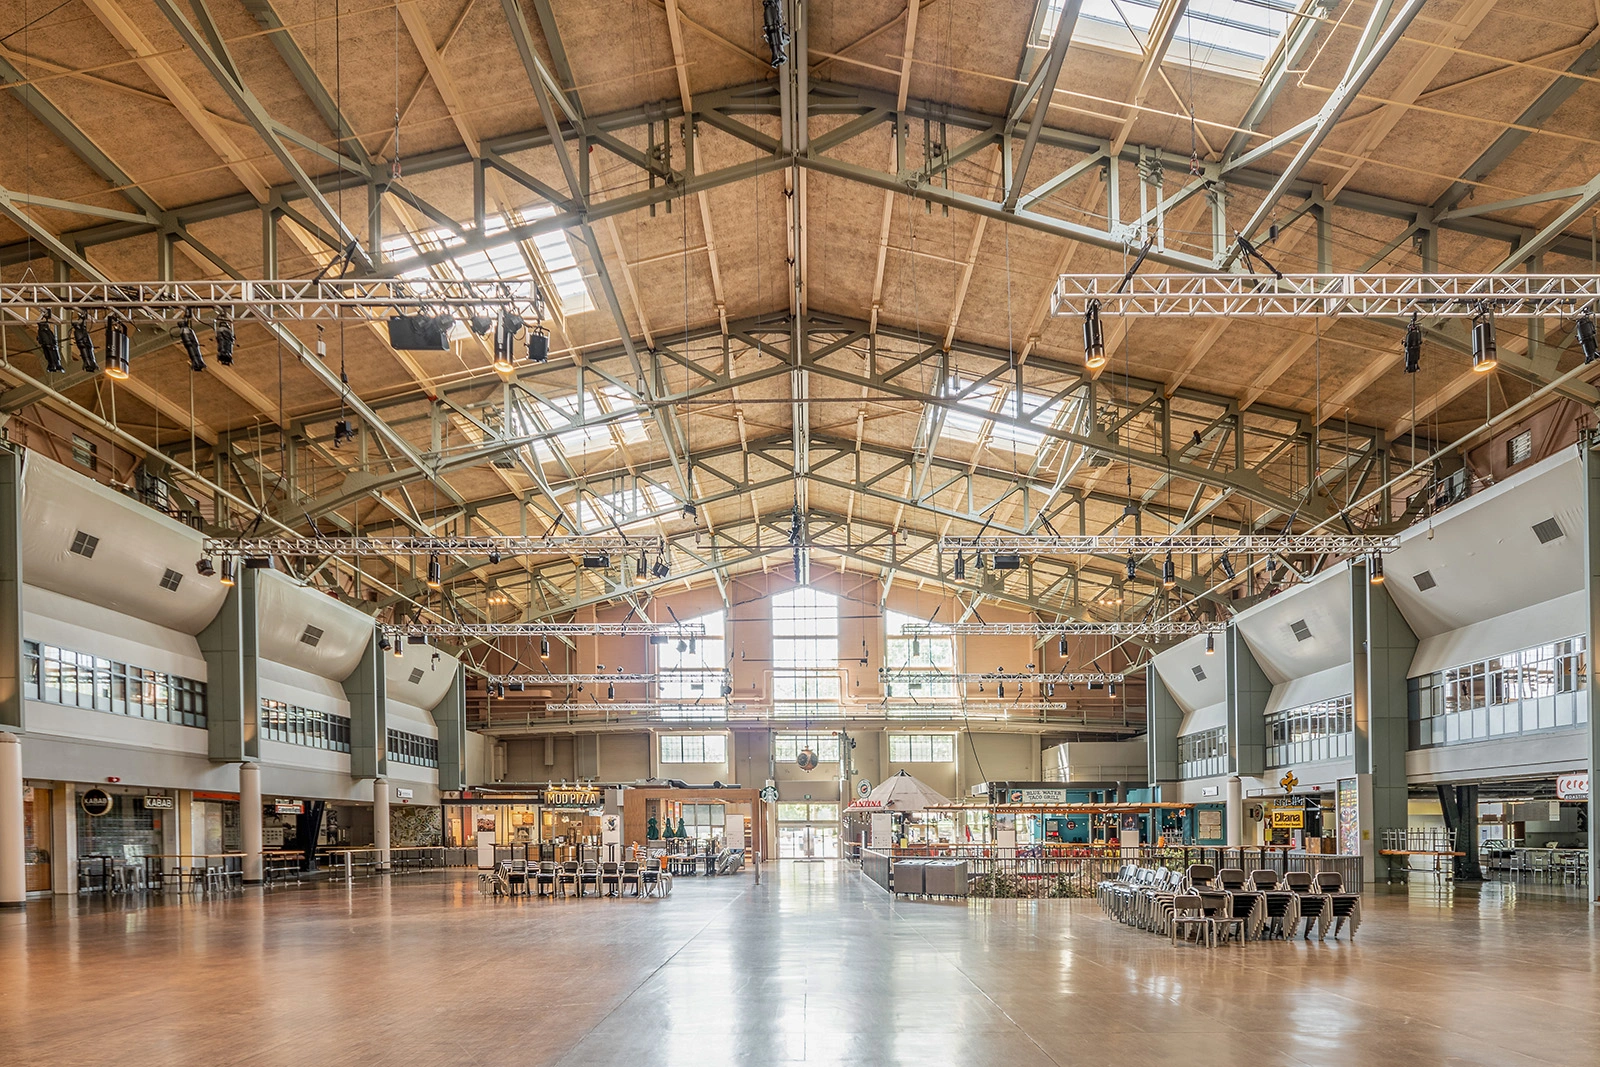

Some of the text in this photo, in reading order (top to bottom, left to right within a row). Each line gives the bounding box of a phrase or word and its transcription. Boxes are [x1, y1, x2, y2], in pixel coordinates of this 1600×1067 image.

[146, 798, 172, 808] KABAB
[547, 793, 596, 804] MOD PIZZA
